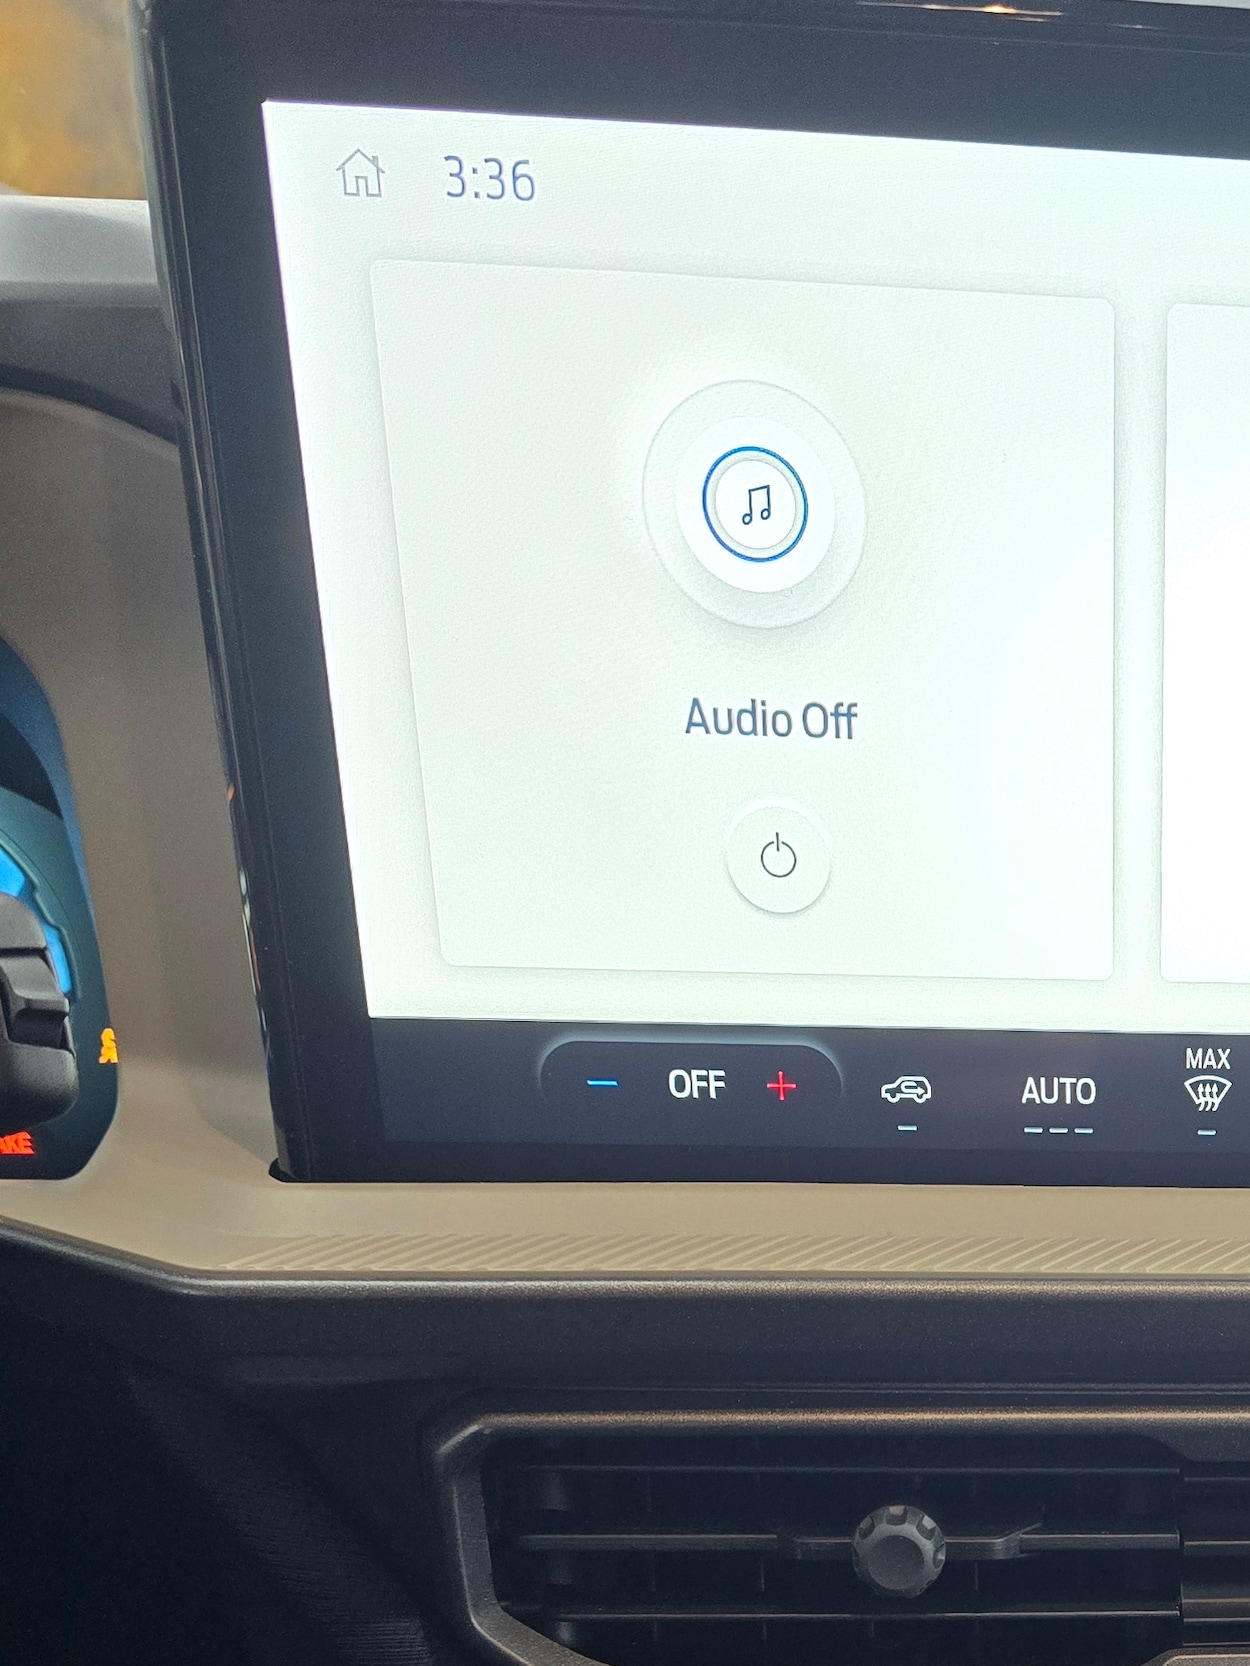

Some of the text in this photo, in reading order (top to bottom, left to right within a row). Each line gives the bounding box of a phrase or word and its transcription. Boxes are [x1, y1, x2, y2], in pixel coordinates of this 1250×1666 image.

[443, 155, 536, 202] 3:36
[684, 697, 859, 740] Audio Off
[1185, 1047, 1231, 1070] MAX
[668, 1069, 726, 1100] OFF
[1021, 1076, 1097, 1106] AUTO
